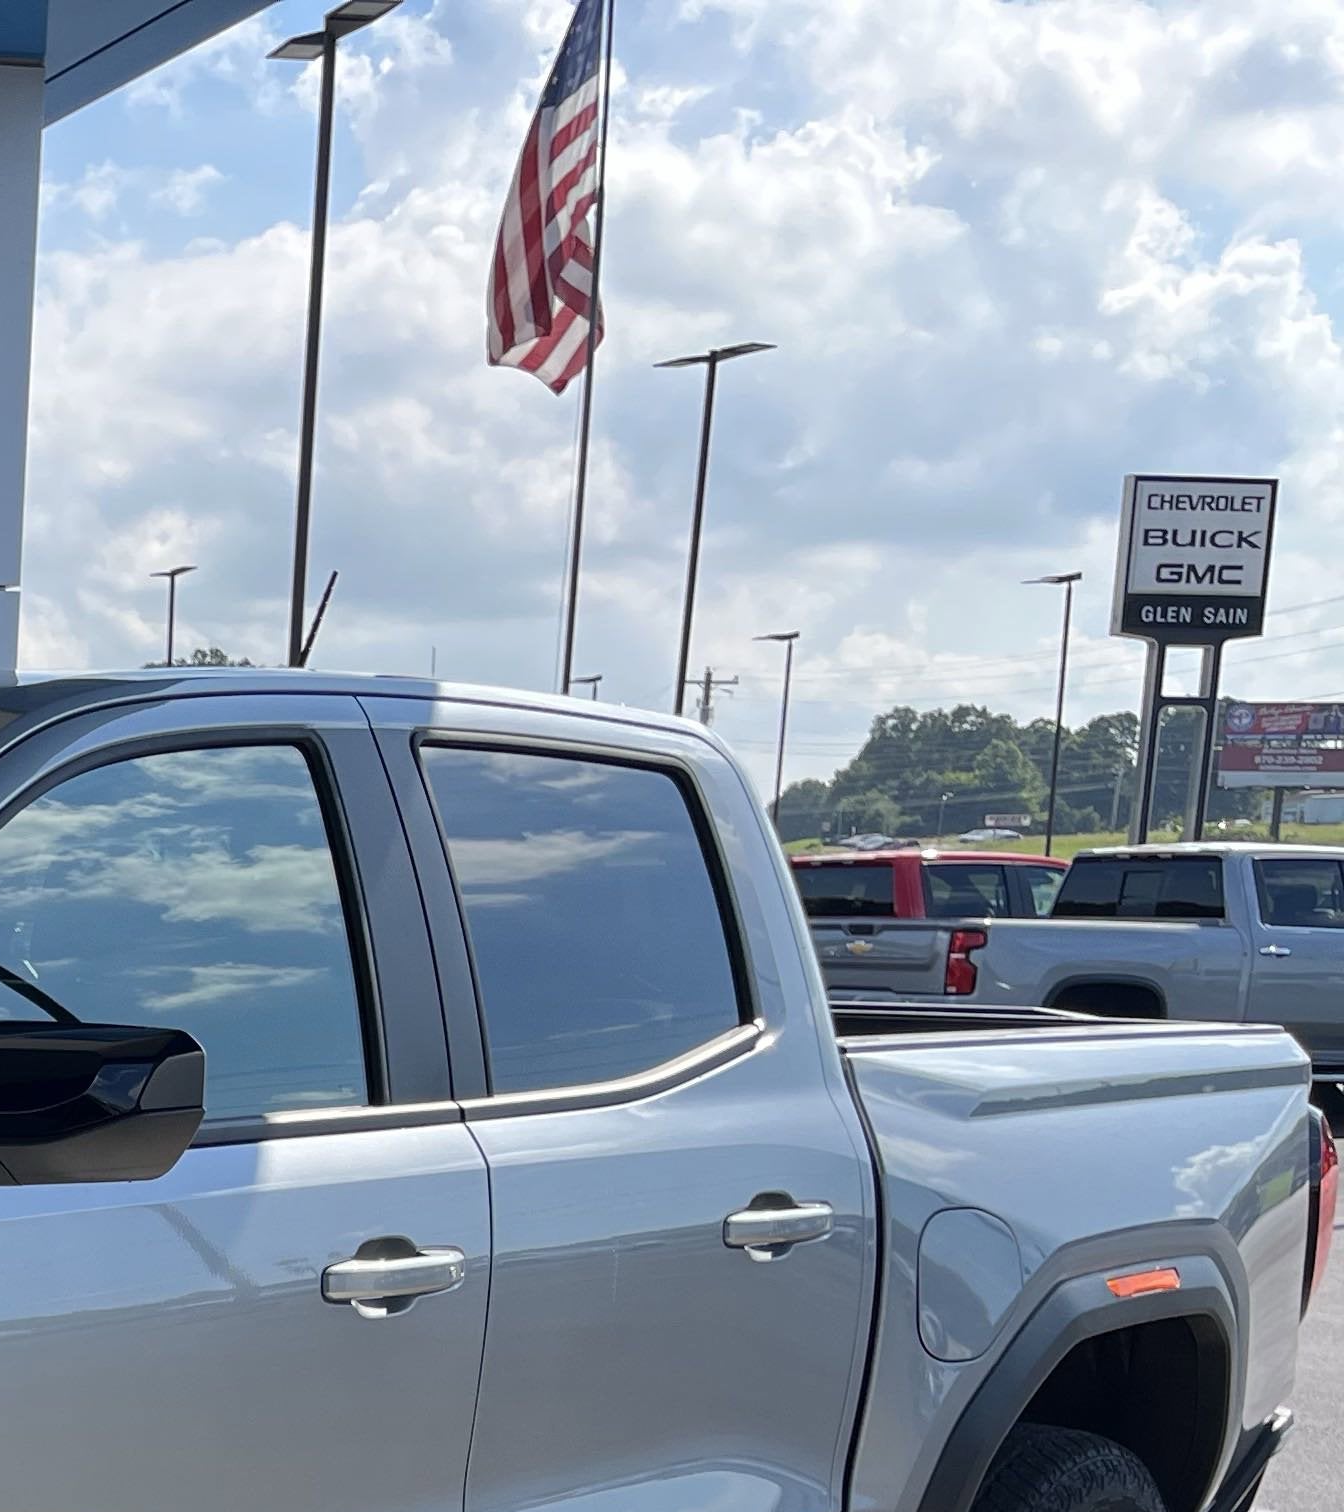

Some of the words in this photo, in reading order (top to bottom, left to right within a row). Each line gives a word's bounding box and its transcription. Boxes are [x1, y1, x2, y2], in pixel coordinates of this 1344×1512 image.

[1147, 493, 1265, 513] CHEVROLET
[1142, 528, 1262, 550] BUICK
[1155, 562, 1244, 585] GMC
[1140, 604, 1192, 624] GLEN
[1202, 605, 1249, 625] SAIN
